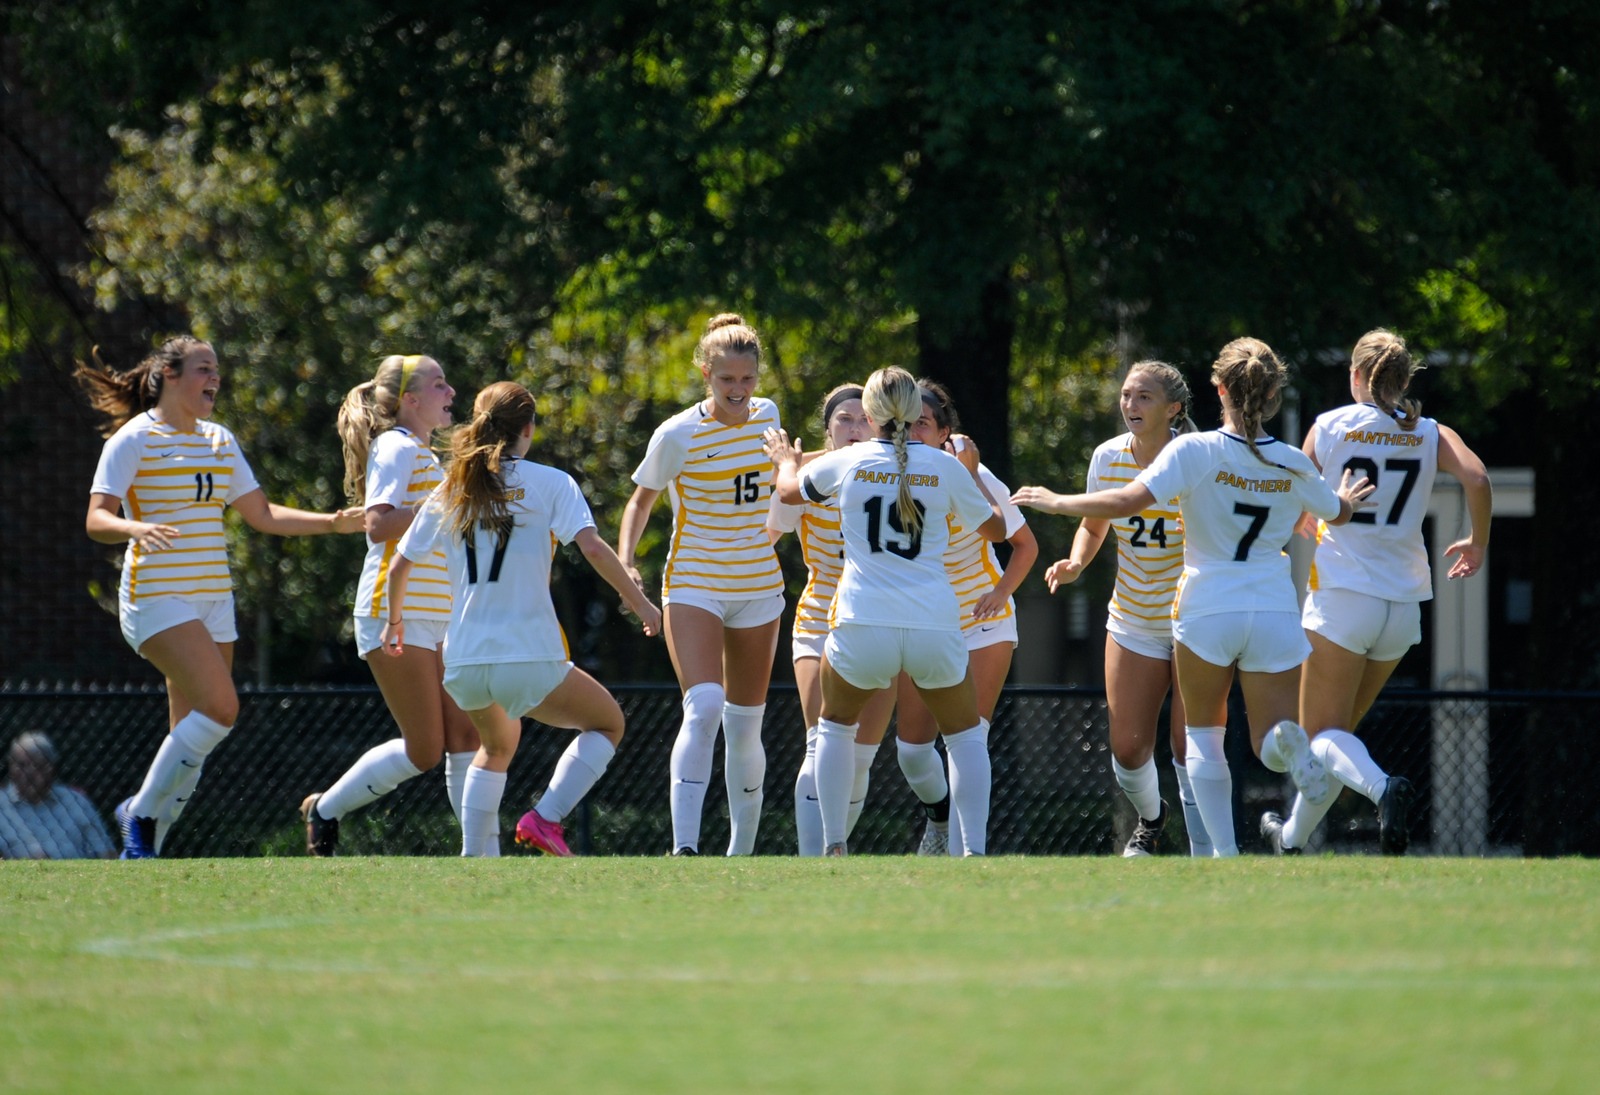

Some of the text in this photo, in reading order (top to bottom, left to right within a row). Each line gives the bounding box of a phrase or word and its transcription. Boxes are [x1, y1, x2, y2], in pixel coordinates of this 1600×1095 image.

[195, 472, 213, 502] 11
[734, 471, 760, 506] 15
[1215, 470, 1292, 492] PANTHERS
[1342, 456, 1422, 526] 27
[461, 513, 514, 584] 17
[864, 495, 927, 561] 19
[1128, 515, 1167, 549] 24
[1233, 501, 1271, 562] 7
